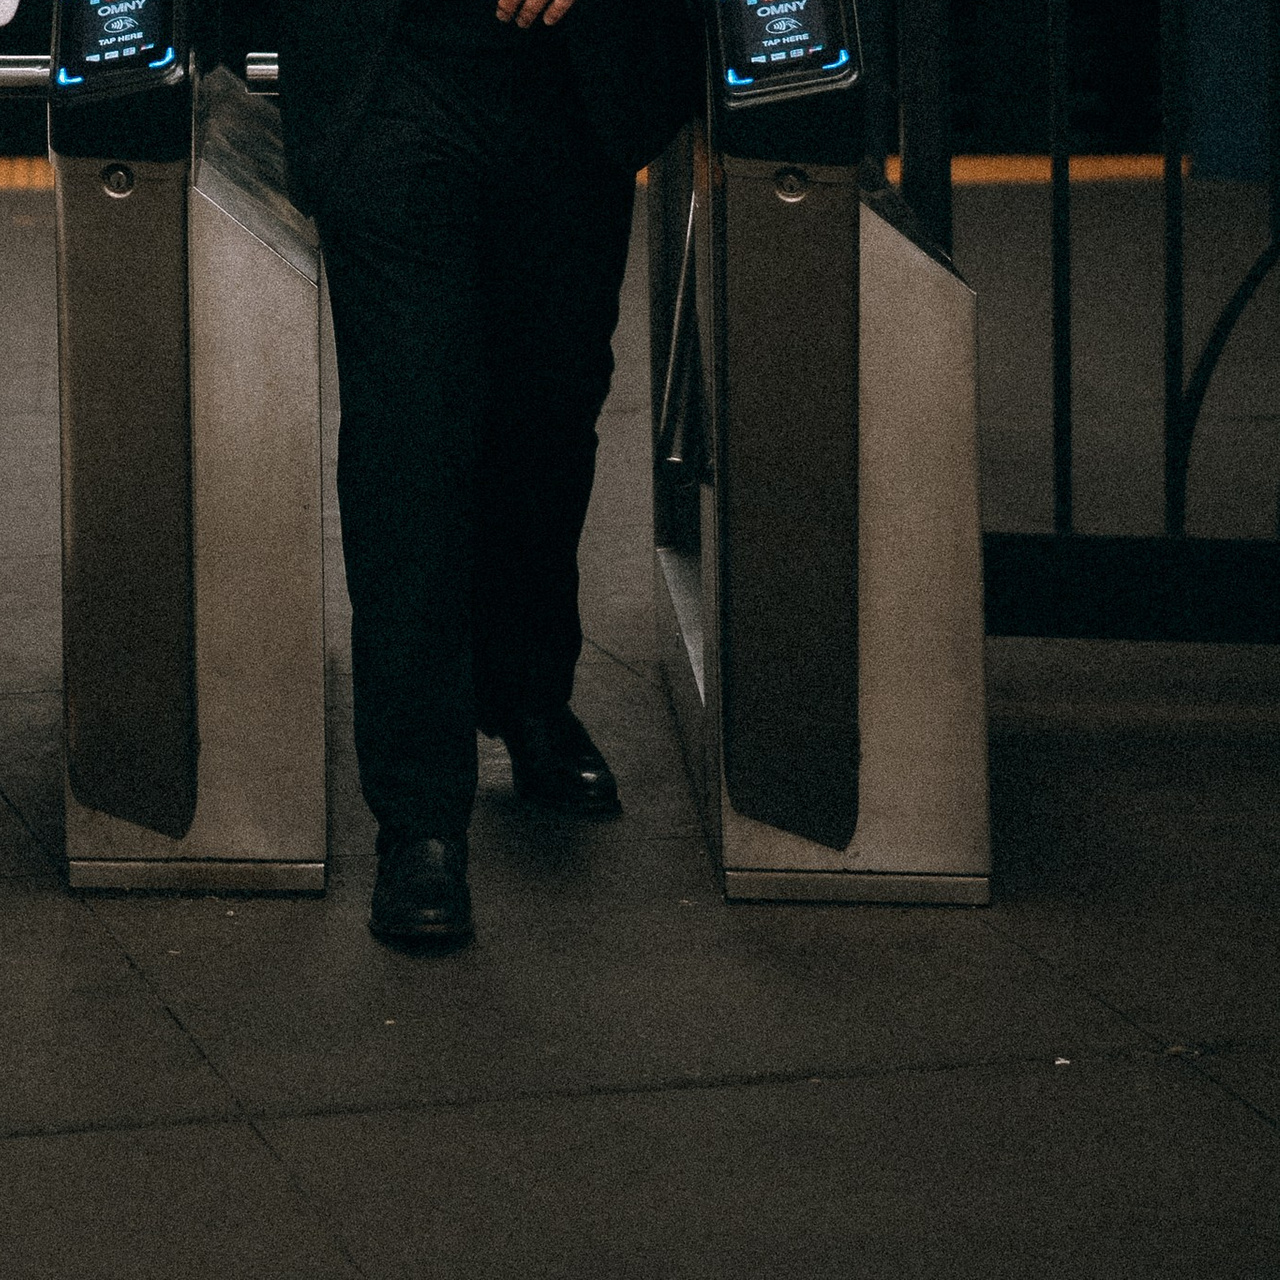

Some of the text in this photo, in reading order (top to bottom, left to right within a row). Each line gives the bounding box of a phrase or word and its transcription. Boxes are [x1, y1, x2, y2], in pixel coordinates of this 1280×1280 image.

[756, 0, 807, 17] OMNY
[98, 32, 144, 46] TAP HERE
[762, 33, 809, 47] TAP HERE
